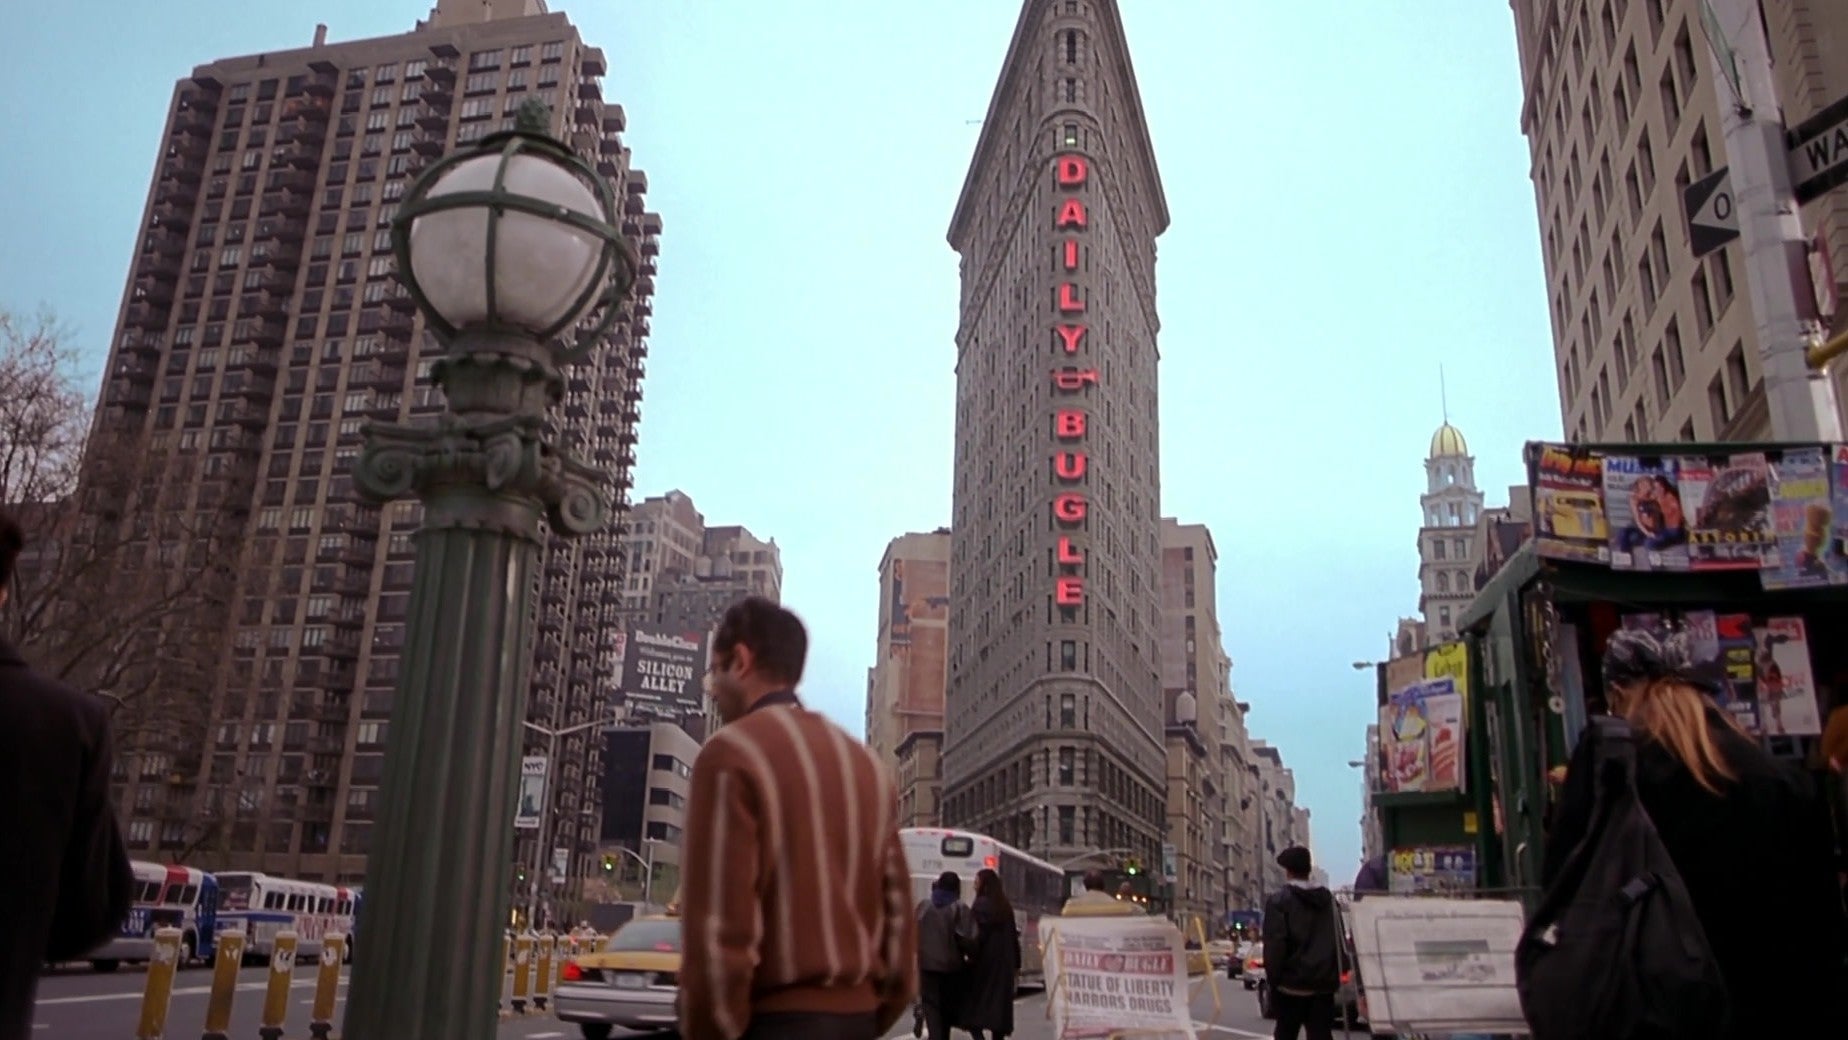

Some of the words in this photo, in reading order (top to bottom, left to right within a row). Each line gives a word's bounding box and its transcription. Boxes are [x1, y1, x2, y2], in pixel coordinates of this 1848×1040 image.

[1806, 124, 1848, 171] WA
[1714, 193, 1731, 220] O
[1056, 154, 1088, 356] DAILY
[1055, 408, 1087, 606] BUGLE
[636, 660, 694, 679] SILICON
[640, 675, 686, 694] ALLEY
[524, 761, 544, 772] NYC
[1068, 972, 1102, 990] TATUE
[1106, 976, 1120, 992] OF
[1125, 978, 1174, 996] LIBERTY
[1129, 997, 1172, 1014] DRUGS
